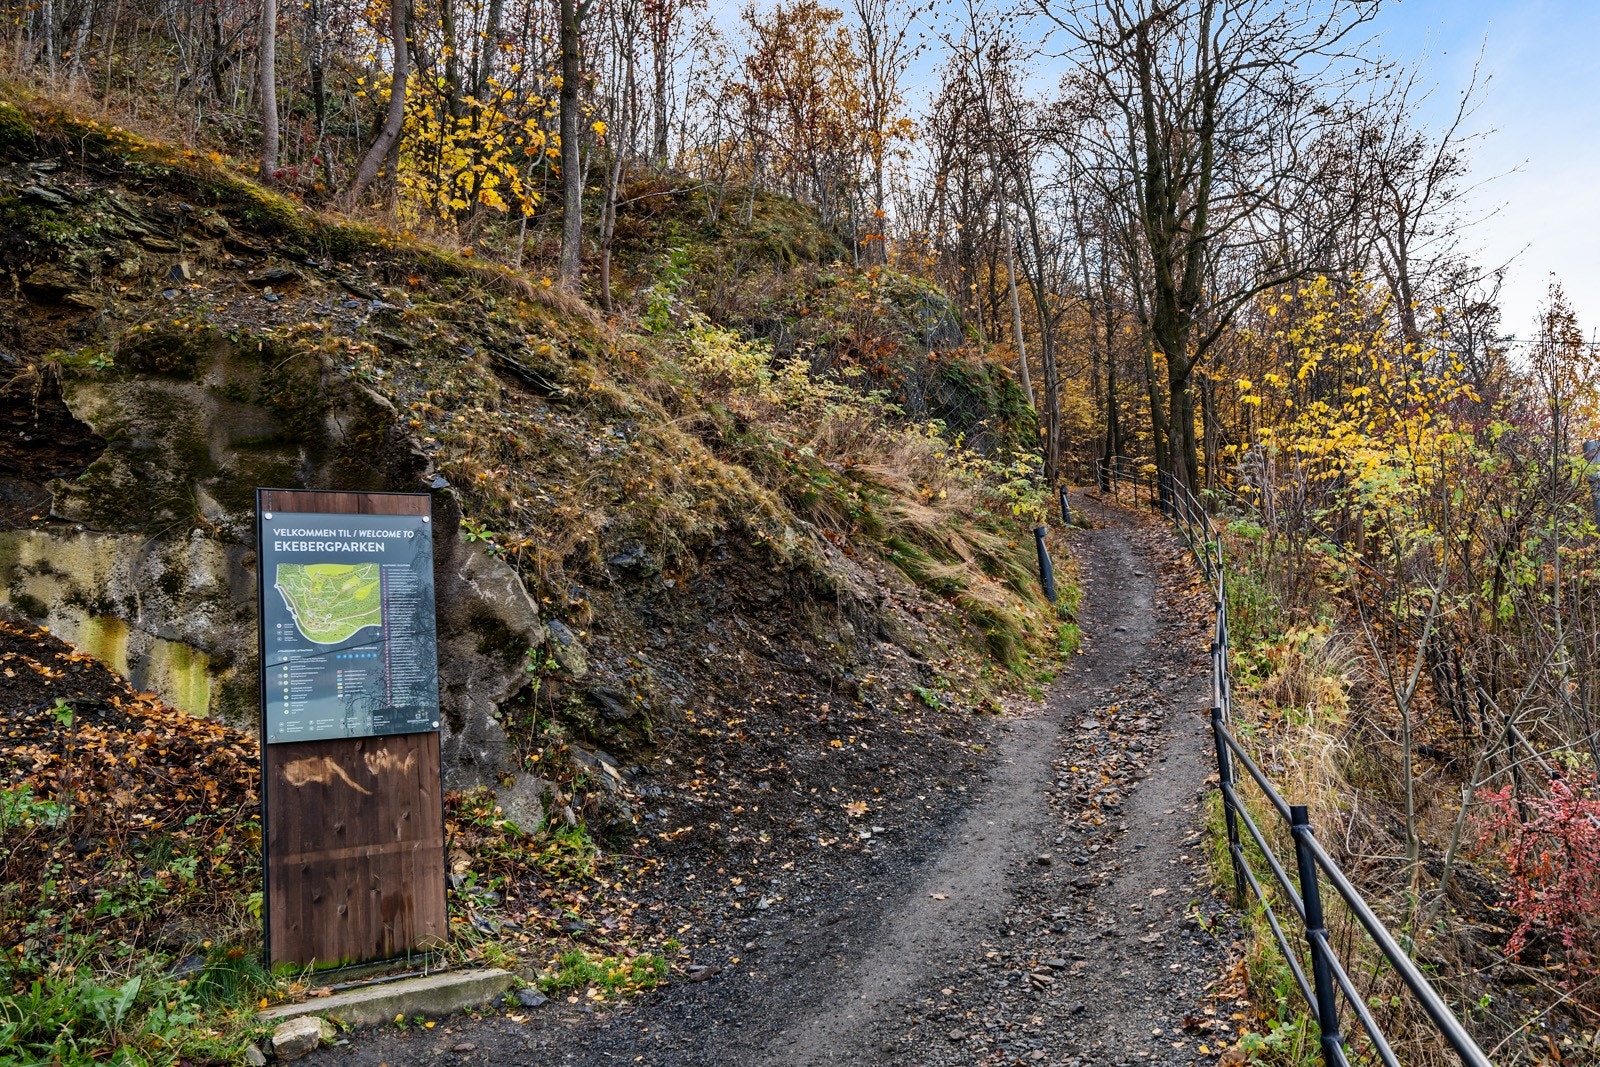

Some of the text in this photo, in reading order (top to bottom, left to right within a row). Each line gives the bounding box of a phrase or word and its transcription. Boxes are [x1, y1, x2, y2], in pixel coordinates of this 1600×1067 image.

[273, 528, 337, 537] VELKOMMEN
[338, 529, 352, 538] TIL
[359, 530, 402, 539] WELCOME
[403, 530, 415, 539] TO
[274, 541, 385, 552] EKEBERGPARKEN
